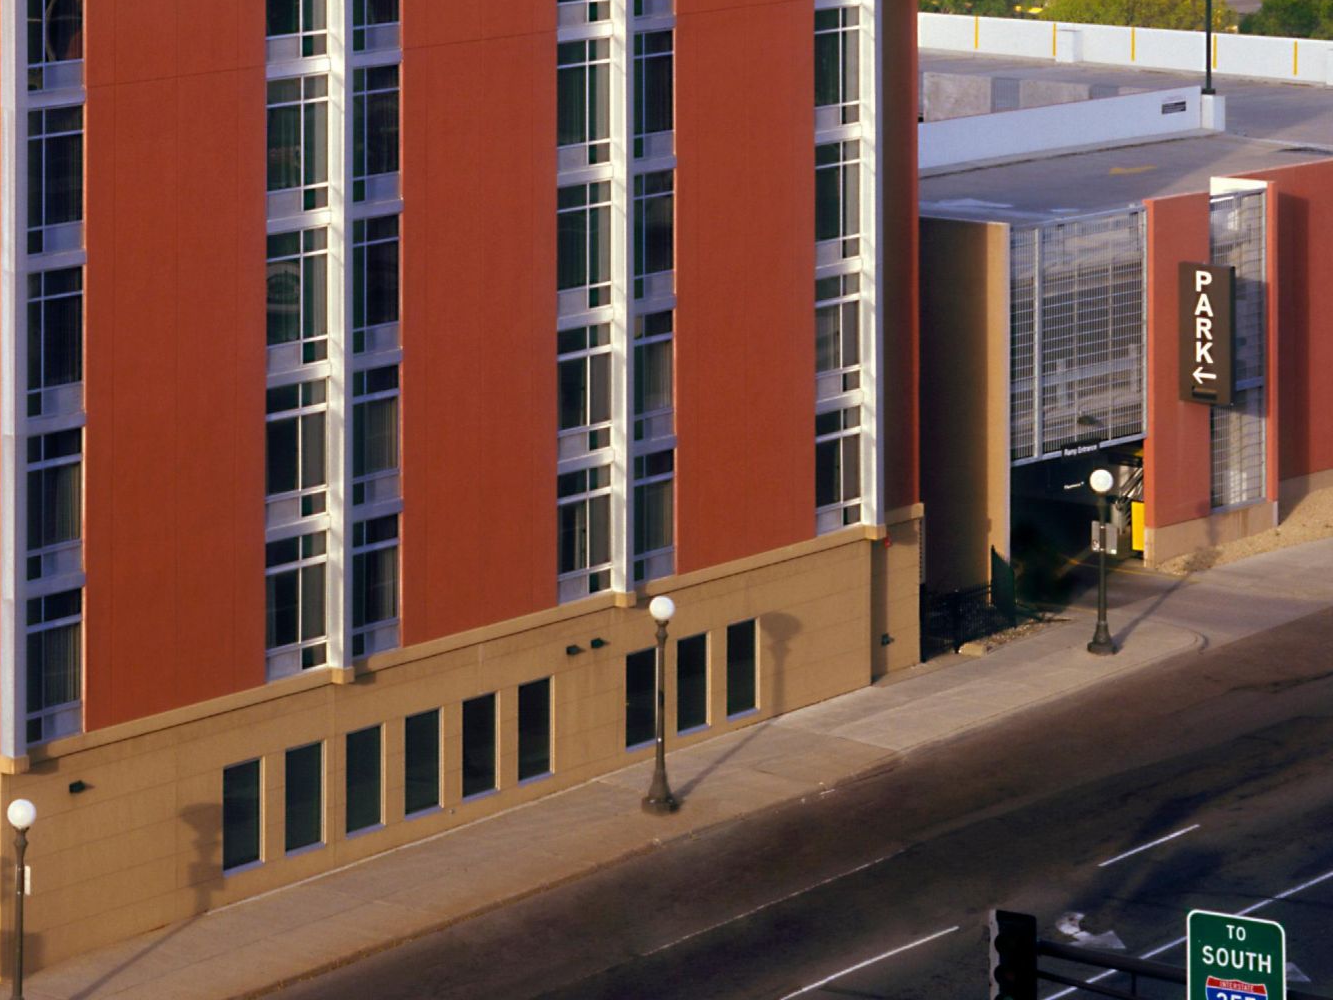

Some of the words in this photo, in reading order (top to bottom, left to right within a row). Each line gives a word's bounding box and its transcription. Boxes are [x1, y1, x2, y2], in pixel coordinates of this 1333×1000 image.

[1194, 270, 1214, 364] PARK
[1226, 924, 1246, 941] TO
[1202, 945, 1271, 974] SOUTH
[1220, 980, 1254, 992] INTERSTATE
